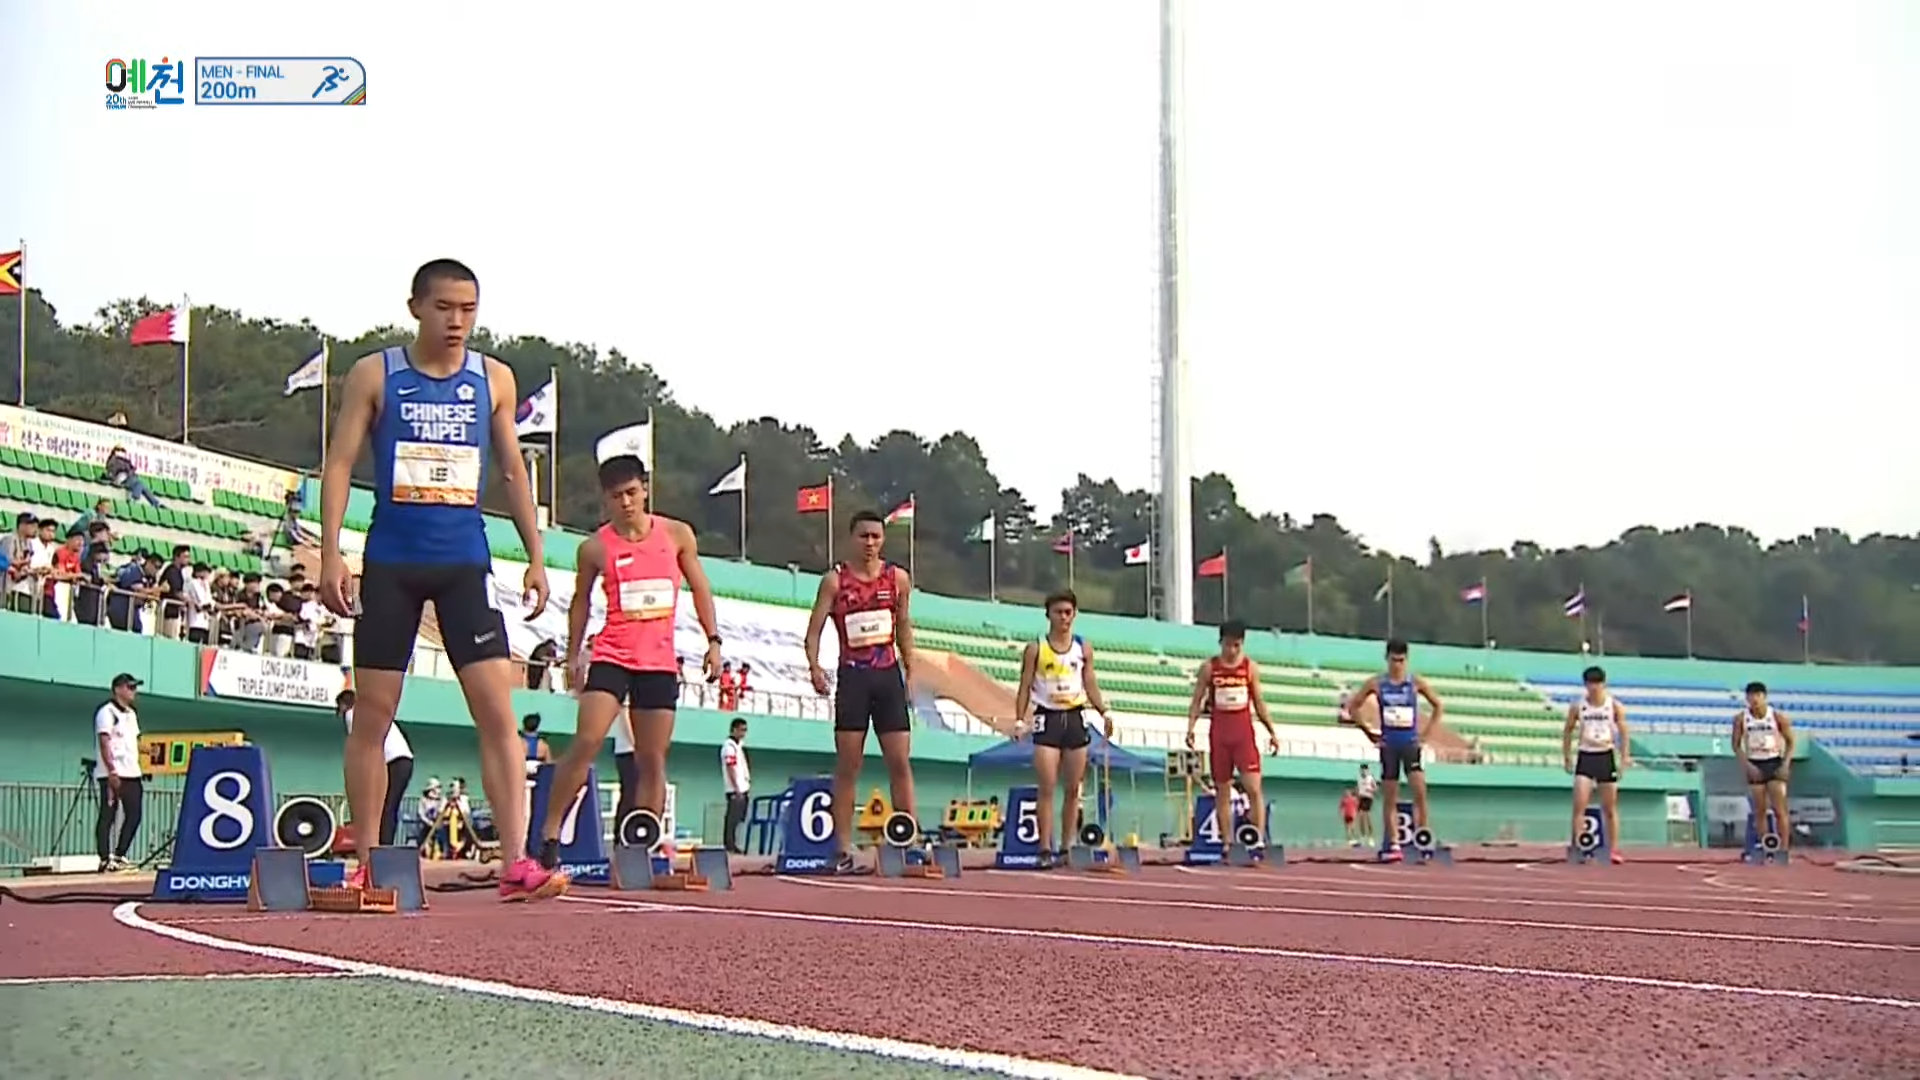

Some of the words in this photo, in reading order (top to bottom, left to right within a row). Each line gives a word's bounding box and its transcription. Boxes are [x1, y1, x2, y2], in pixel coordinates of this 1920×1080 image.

[401, 402, 477, 423] CHINESE
[410, 422, 466, 442] TAIPEI
[430, 467, 448, 482] LEE
[261, 660, 281, 677] LONG
[282, 662, 301, 680] JUMP
[238, 676, 263, 697] TRIPLE
[265, 679, 284, 698] JUMP
[286, 681, 309, 700] COACH
[310, 685, 329, 702] AREA
[199, 771, 254, 849] 8
[801, 791, 834, 842] 6
[1017, 800, 1040, 843] 5
[1199, 808, 1222, 843] 4
